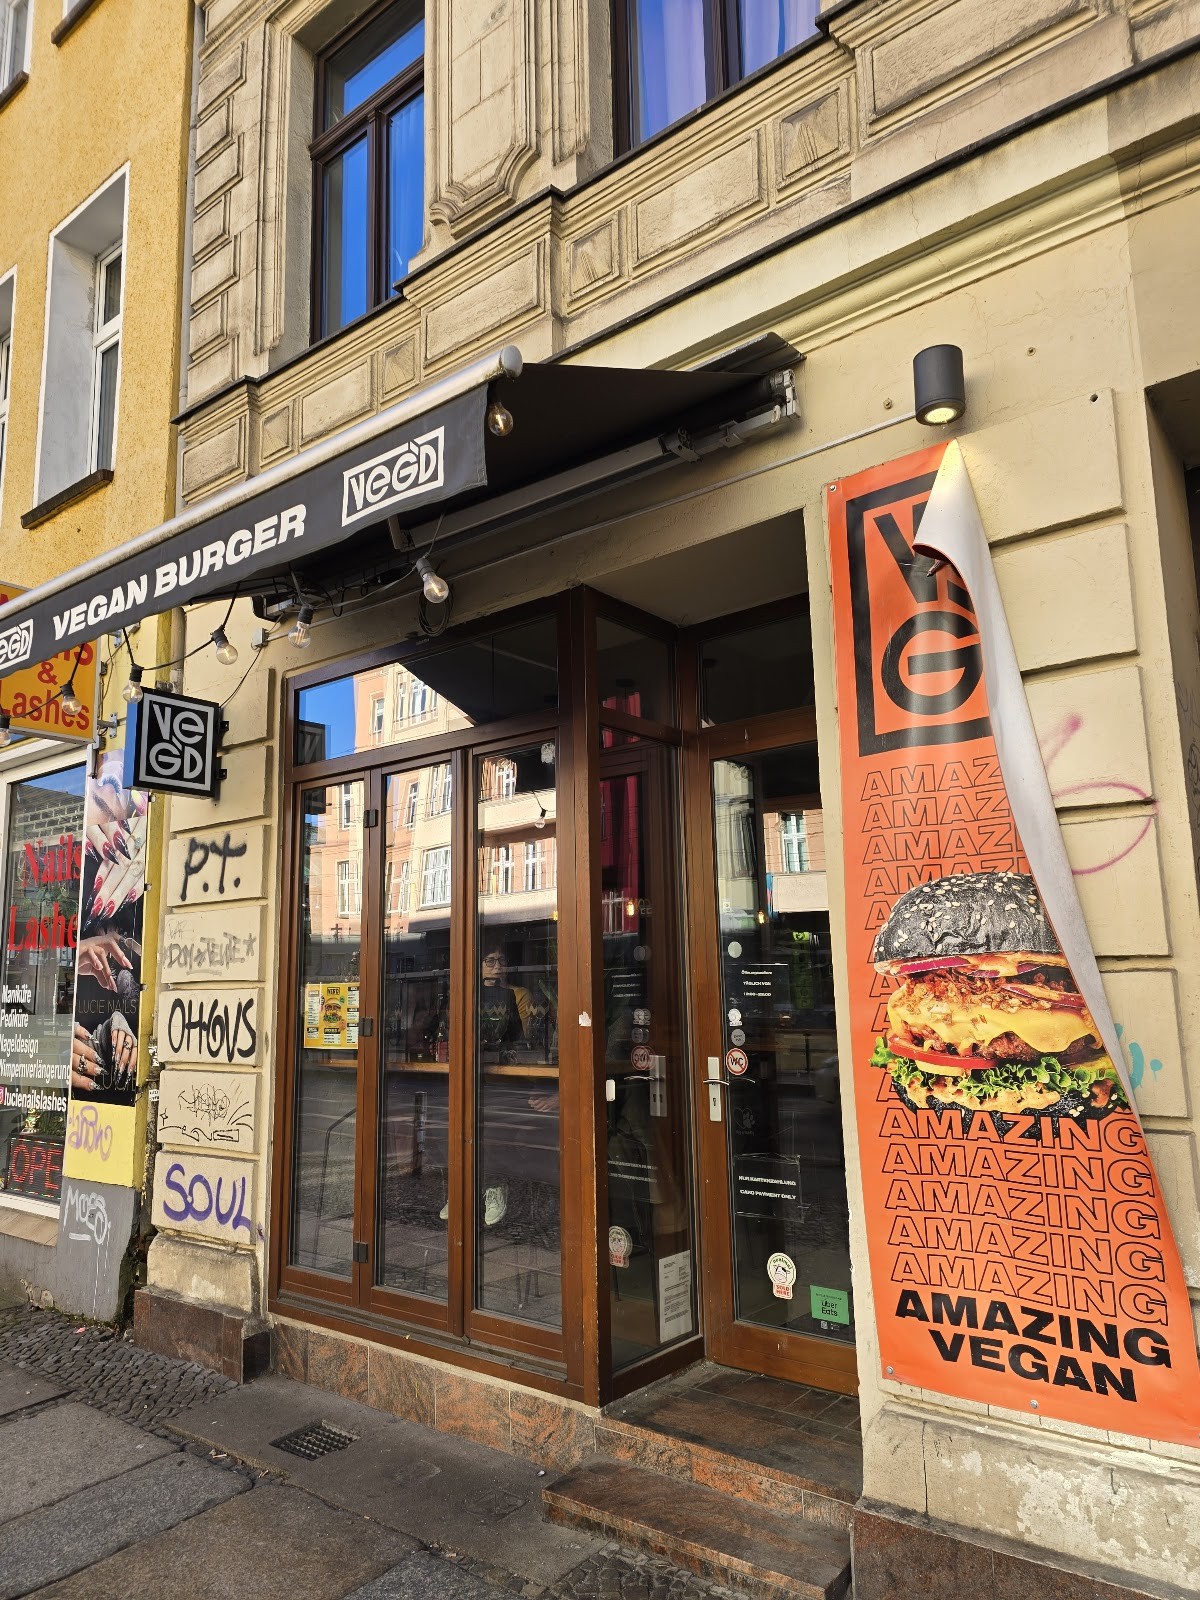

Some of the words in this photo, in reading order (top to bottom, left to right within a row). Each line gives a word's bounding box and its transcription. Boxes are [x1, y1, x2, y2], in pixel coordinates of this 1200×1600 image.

[53, 575, 148, 641] VEGAN
[153, 503, 307, 598] BURGER
[37, 661, 58, 686] &
[861, 755, 1004, 801] AMAZ
[862, 787, 1012, 834] AMAZ
[21, 834, 82, 888] Nails
[863, 822, 1026, 865] AMAZ
[7, 901, 78, 951] Lashe
[2, 983, 32, 1004] Maniküre
[79, 999, 105, 1014] LUCIE
[107, 999, 137, 1014] NAILS
[0, 1008, 29, 1028] Pediküre
[730, 1056, 743, 1066] WC
[4, 1087, 67, 1112] lucienailslashes
[879, 1107, 1148, 1156] AMAZING
[11, 1143, 63, 1190] OPE
[882, 1143, 1155, 1197] AMAZING
[163, 1163, 251, 1230] SOUL
[885, 1178, 1161, 1240] AMAZING
[888, 1215, 1166, 1282] AMAZING
[821, 1307, 838, 1317] Eats
[891, 1251, 1169, 1326] AMAZING
[895, 1289, 1172, 1369] AMAZING
[928, 1328, 1138, 1402] VEGAN
